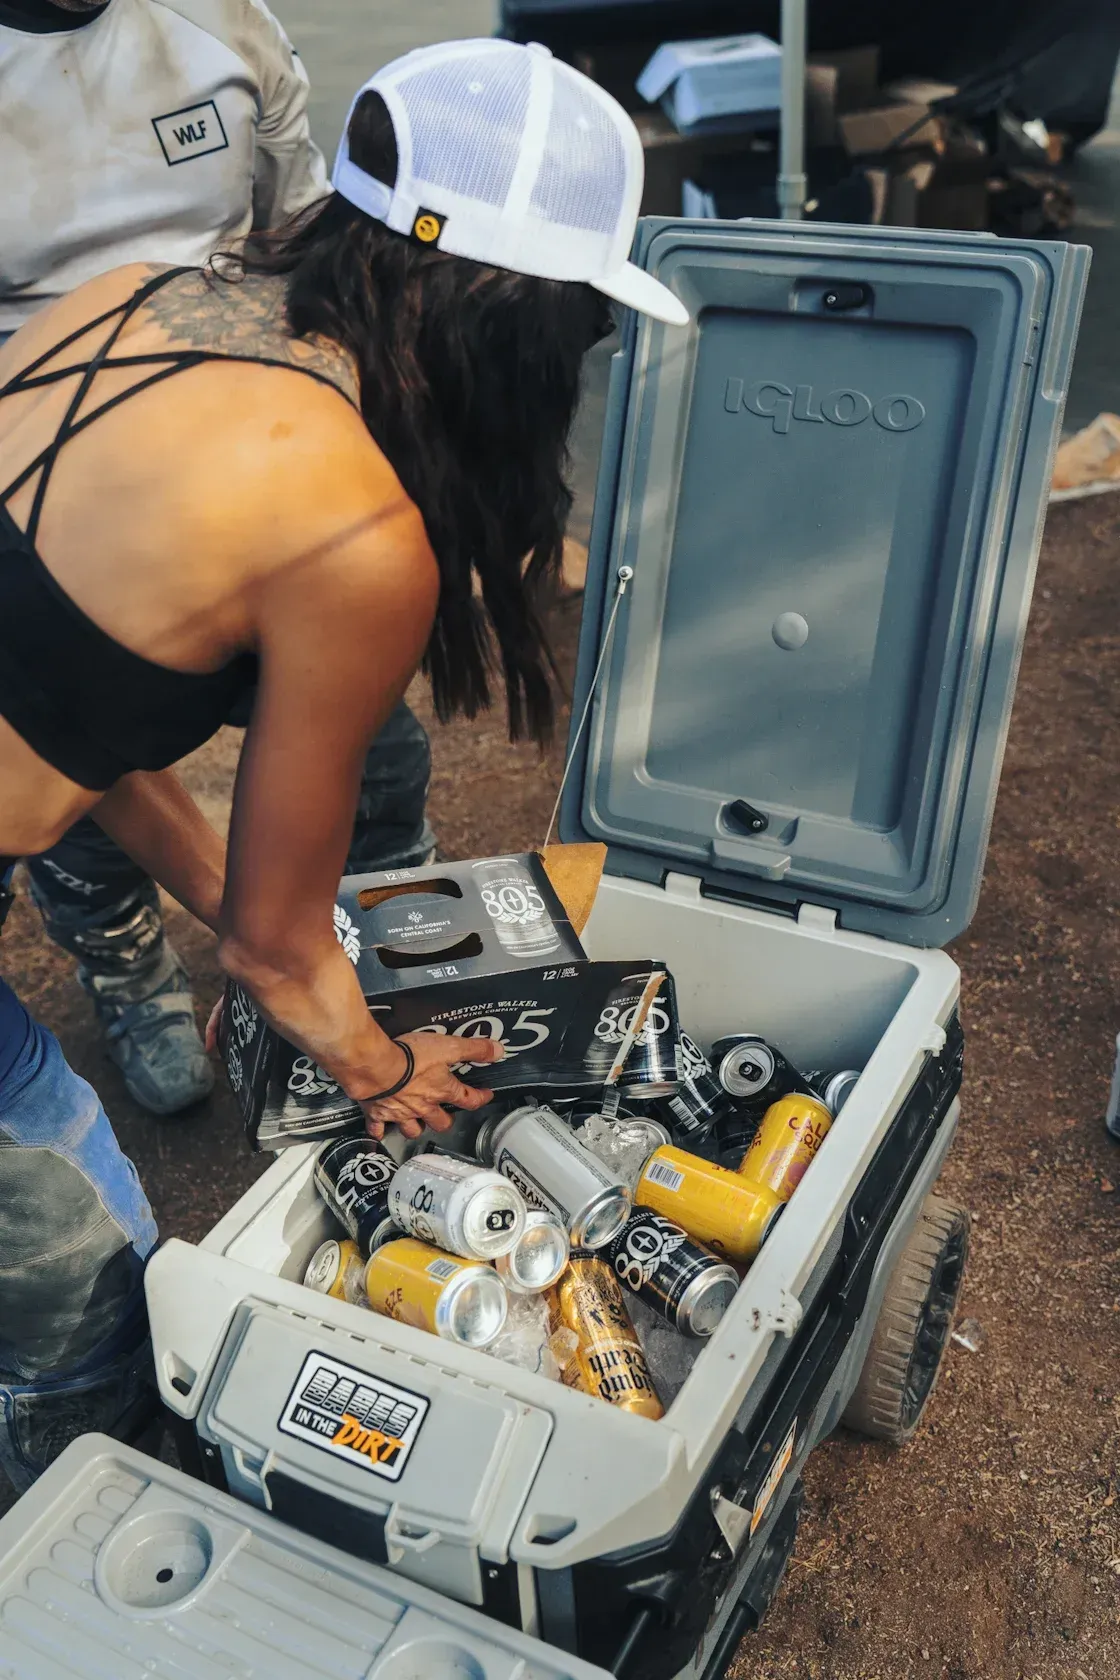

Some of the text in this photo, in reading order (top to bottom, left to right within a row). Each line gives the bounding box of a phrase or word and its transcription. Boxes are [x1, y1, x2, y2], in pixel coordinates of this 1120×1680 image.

[172, 120, 207, 146] WLF
[724, 377, 926, 435] IGLOO
[384, 873, 398, 881] 12
[480, 885, 546, 917] 805
[446, 965, 459, 976] 12
[542, 970, 556, 980] 12
[431, 1000, 538, 1022] FIRESTONE WALKER
[448, 1010, 482, 1021] BREWING
[615, 1216, 688, 1291] 805
[300, 1366, 419, 1439] BABES
[295, 1408, 406, 1465] IN THE DIRT
